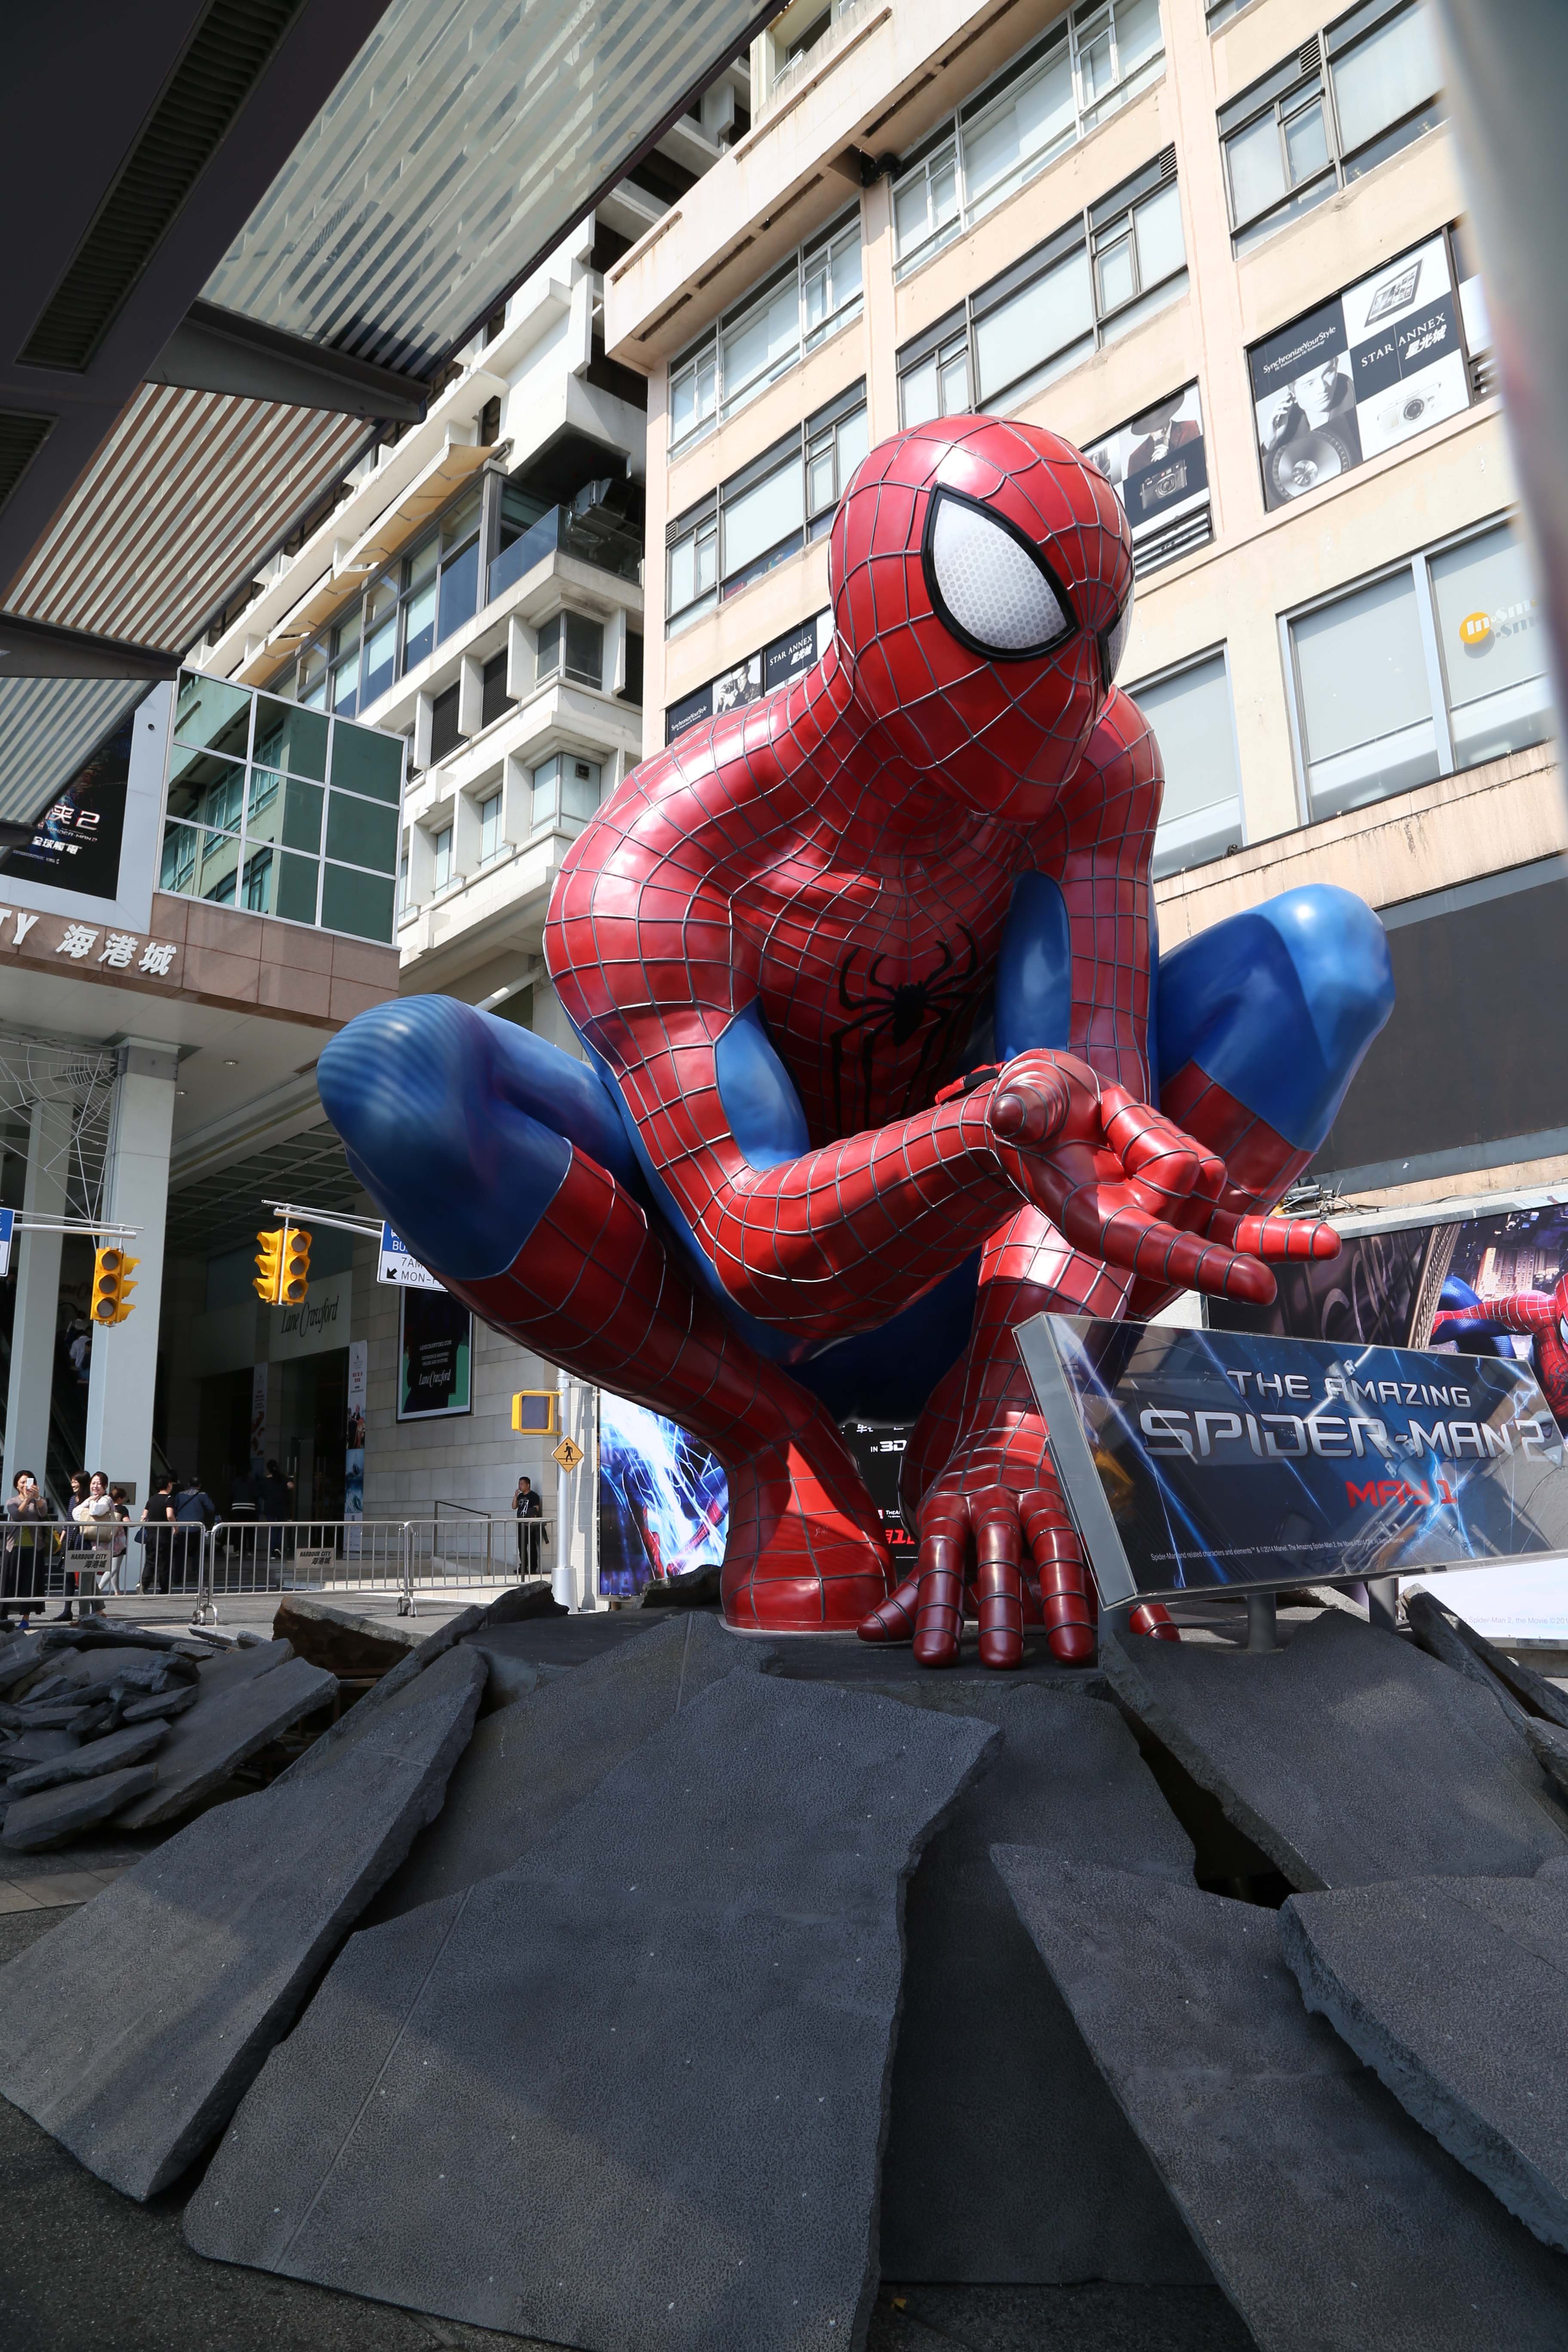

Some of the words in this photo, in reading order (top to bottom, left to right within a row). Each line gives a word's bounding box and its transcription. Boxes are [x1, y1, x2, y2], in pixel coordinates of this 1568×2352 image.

[1263, 327, 1335, 373] SynchronizeYourStyle
[1361, 344, 1394, 367] STAR
[1398, 312, 1446, 346] ANNEX
[1405, 324, 1447, 360] 星光城
[770, 651, 787, 666] STAR
[788, 634, 812, 655] ANNEX
[55, 924, 177, 976] 海港城
[392, 1240, 407, 1252] BU
[281, 1310, 300, 1333] Lane
[300, 1295, 339, 1337] Crawford
[1227, 1370, 1311, 1399] THE
[1324, 1377, 1472, 1407] AMAZING
[880, 1440, 907, 1452] 3D
[1139, 1409, 1514, 1458] SPIDER-MAN
[1514, 1418, 1545, 1461] 2
[1345, 1480, 1432, 1507] MAY
[1436, 1480, 1457, 1504] 1
[83, 1560, 107, 1568] 海港城
[1151, 1553, 1176, 1561] Spider-Man
[1469, 1617, 1507, 1625] Spider-Man
